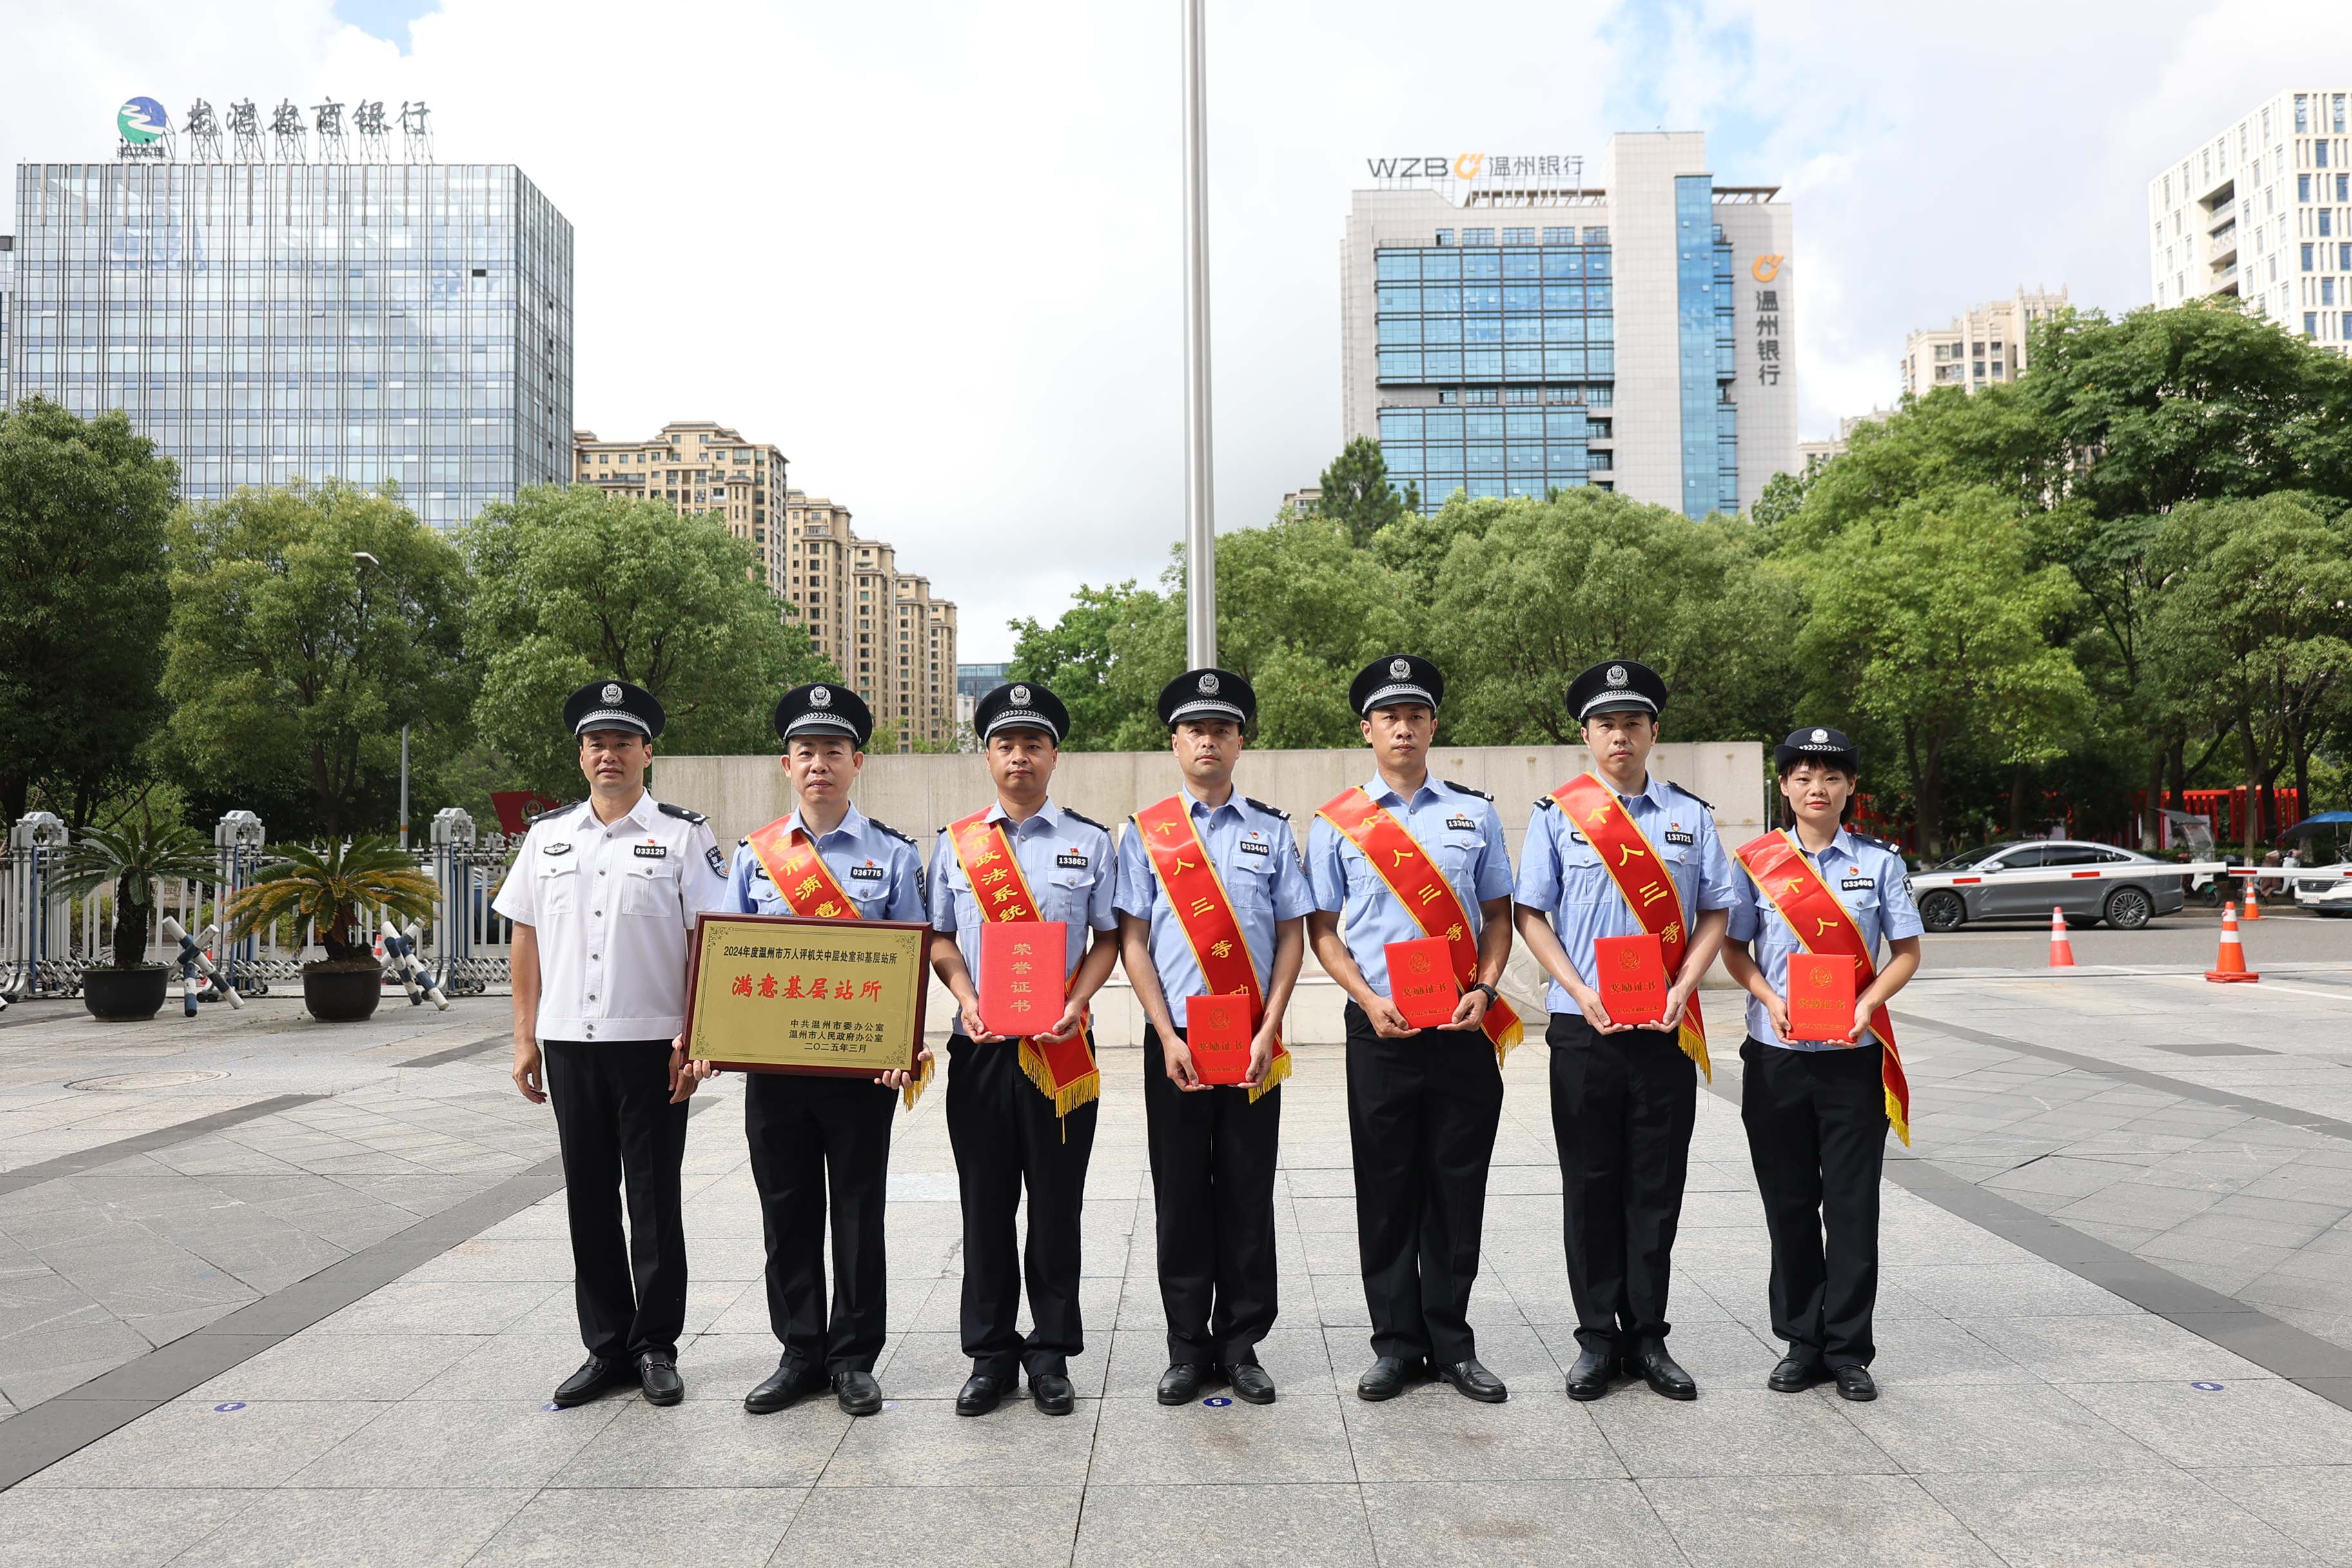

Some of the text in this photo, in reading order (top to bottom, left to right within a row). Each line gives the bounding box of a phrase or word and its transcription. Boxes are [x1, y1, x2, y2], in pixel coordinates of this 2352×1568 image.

[181, 96, 431, 135] 龙湾农商银行
[1367, 155, 1583, 178] WZB 温州银行
[1756, 291, 1781, 386] 温州银行
[636, 847, 665, 856] 033125
[1242, 842, 1268, 853] 033445
[1059, 857, 1086, 866] 133862
[853, 868, 881, 877] 036775
[1843, 879, 1874, 888] 033408
[724, 946, 897, 965] 2024年度温州市万人评机关中层处室和基层站所
[1009, 943, 1033, 1013] 荣誉证书
[731, 972, 883, 1002] 满意基层站所
[790, 1019, 885, 1032] 中共温州市委办公室
[789, 1030, 884, 1043] 温州市人民政府办公室
